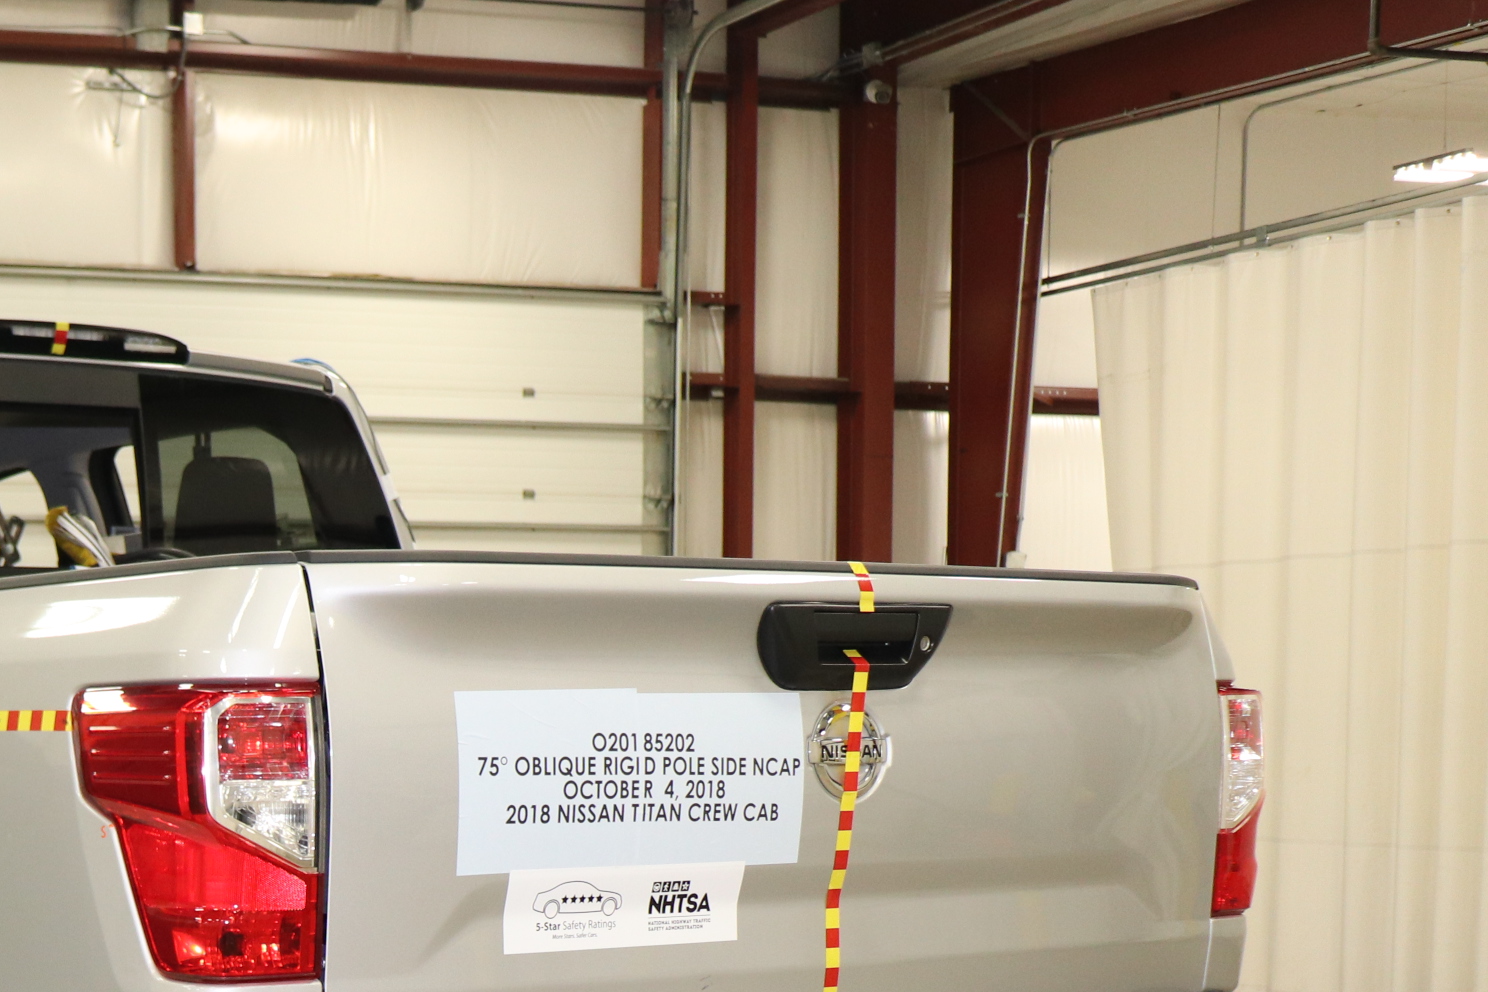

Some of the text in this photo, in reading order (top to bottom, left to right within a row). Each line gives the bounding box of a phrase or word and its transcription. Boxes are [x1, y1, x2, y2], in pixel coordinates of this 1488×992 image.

[821, 744, 882, 759] NISAN
[515, 756, 596, 777] OBLIQUE
[603, 756, 656, 776] RIGID
[663, 756, 705, 776] POLE
[710, 756, 747, 776] SIDE
[753, 757, 801, 776] NCAP
[563, 779, 726, 801] OCTOBER 4, 2018
[505, 803, 779, 824] 2018 NISSAN TITAN CREW CAB
[648, 893, 711, 914] NHTSA
[536, 919, 617, 931] 5-Star Safety Ratings
